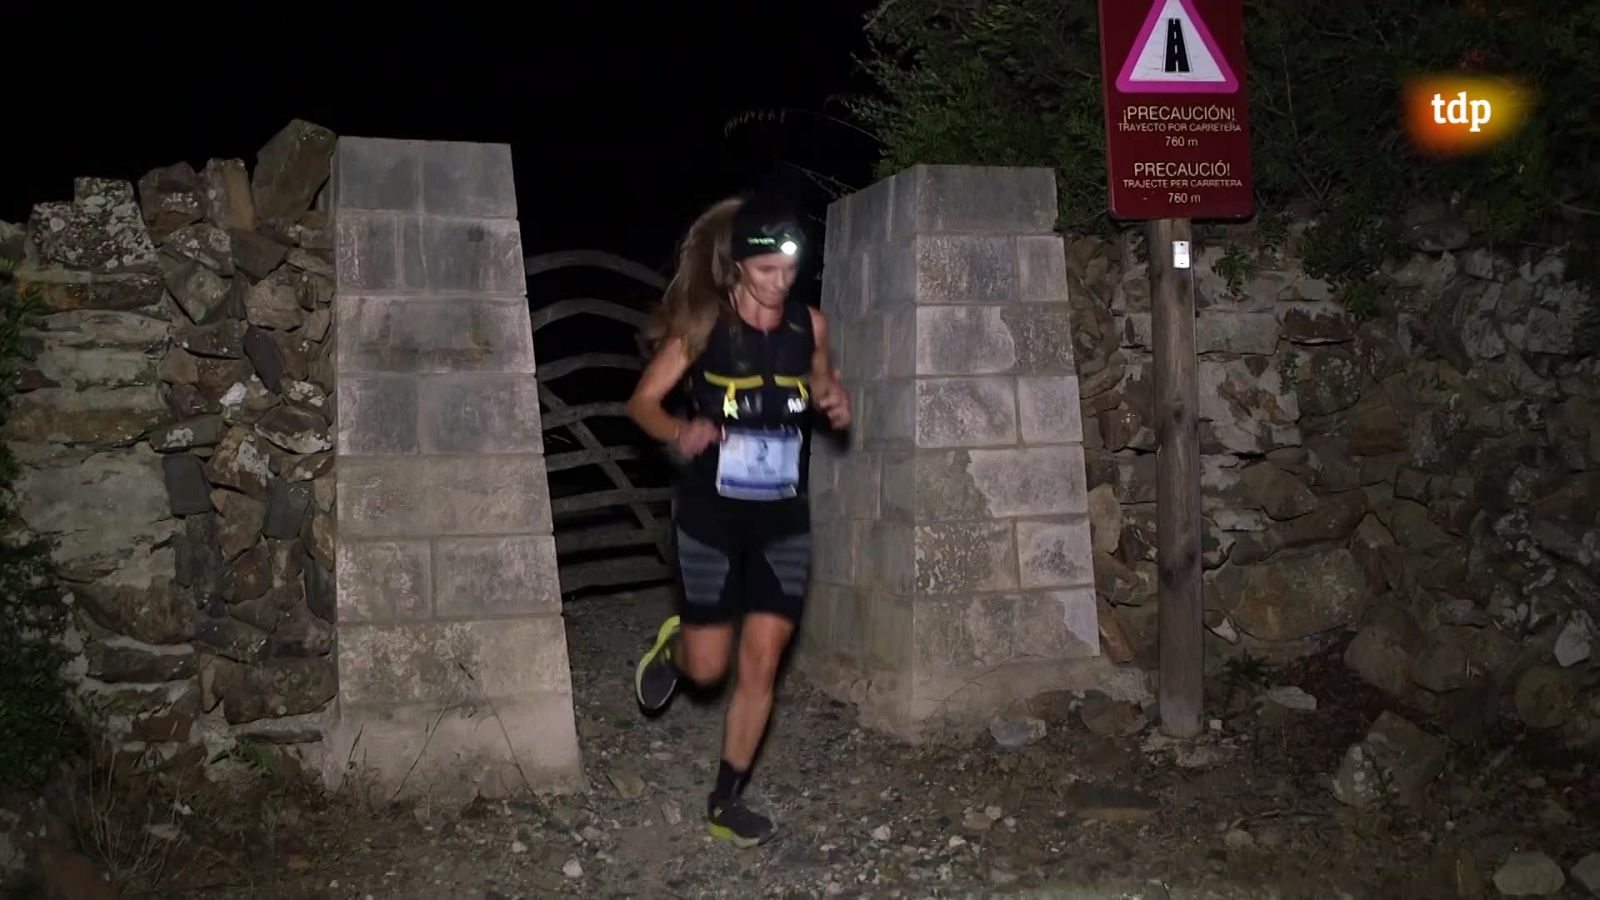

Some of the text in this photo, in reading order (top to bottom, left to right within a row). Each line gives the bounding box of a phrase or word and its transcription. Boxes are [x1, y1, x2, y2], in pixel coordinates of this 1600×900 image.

[1123, 105, 1235, 124] ¡PRECAUCIÓN!
[1118, 122, 1241, 132] TRAYECTO POR CARRETERA
[1165, 136, 1198, 147] 760 m
[1134, 160, 1231, 177] PRECAUCIÓ!
[1123, 179, 1243, 188] TRAJECTE PER CARRETERA
[1168, 192, 1201, 203] 760 m
